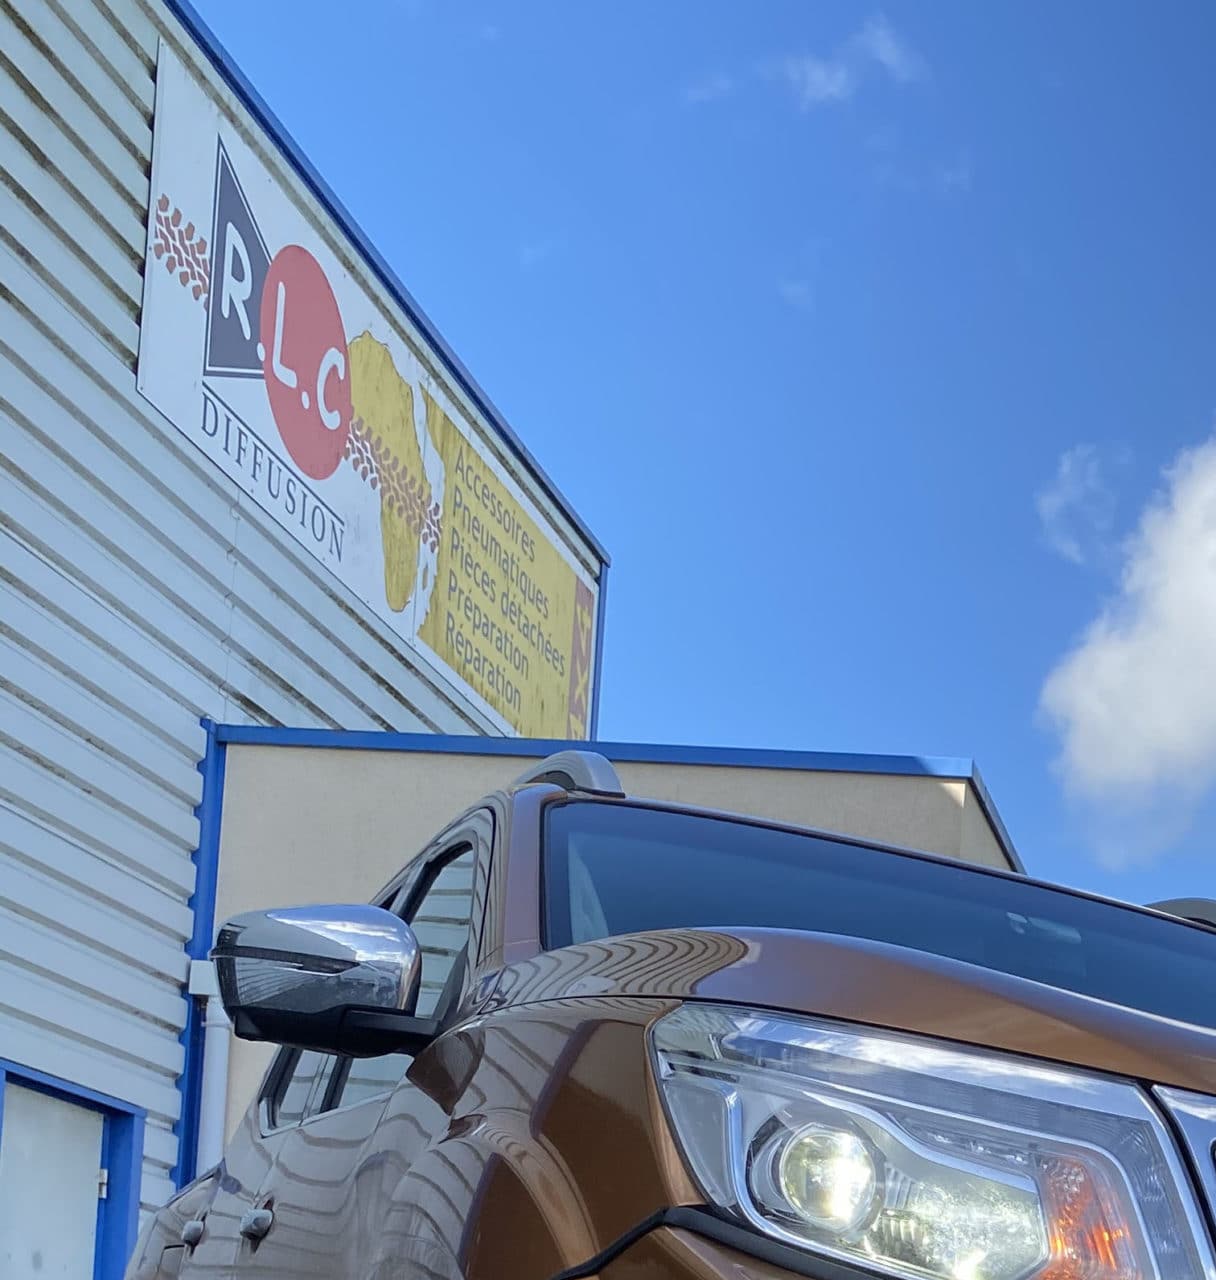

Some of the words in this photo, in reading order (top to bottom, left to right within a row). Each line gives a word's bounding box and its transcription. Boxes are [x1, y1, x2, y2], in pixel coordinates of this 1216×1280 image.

[201, 391, 345, 563] DIFFUSION
[455, 445, 535, 562] Accessoires
[451, 527, 496, 603] Pièces
[501, 574, 565, 677] détachées
[453, 484, 548, 620] Pneumatiques
[446, 611, 521, 713] Réparation
[448, 568, 529, 681] Préparation
